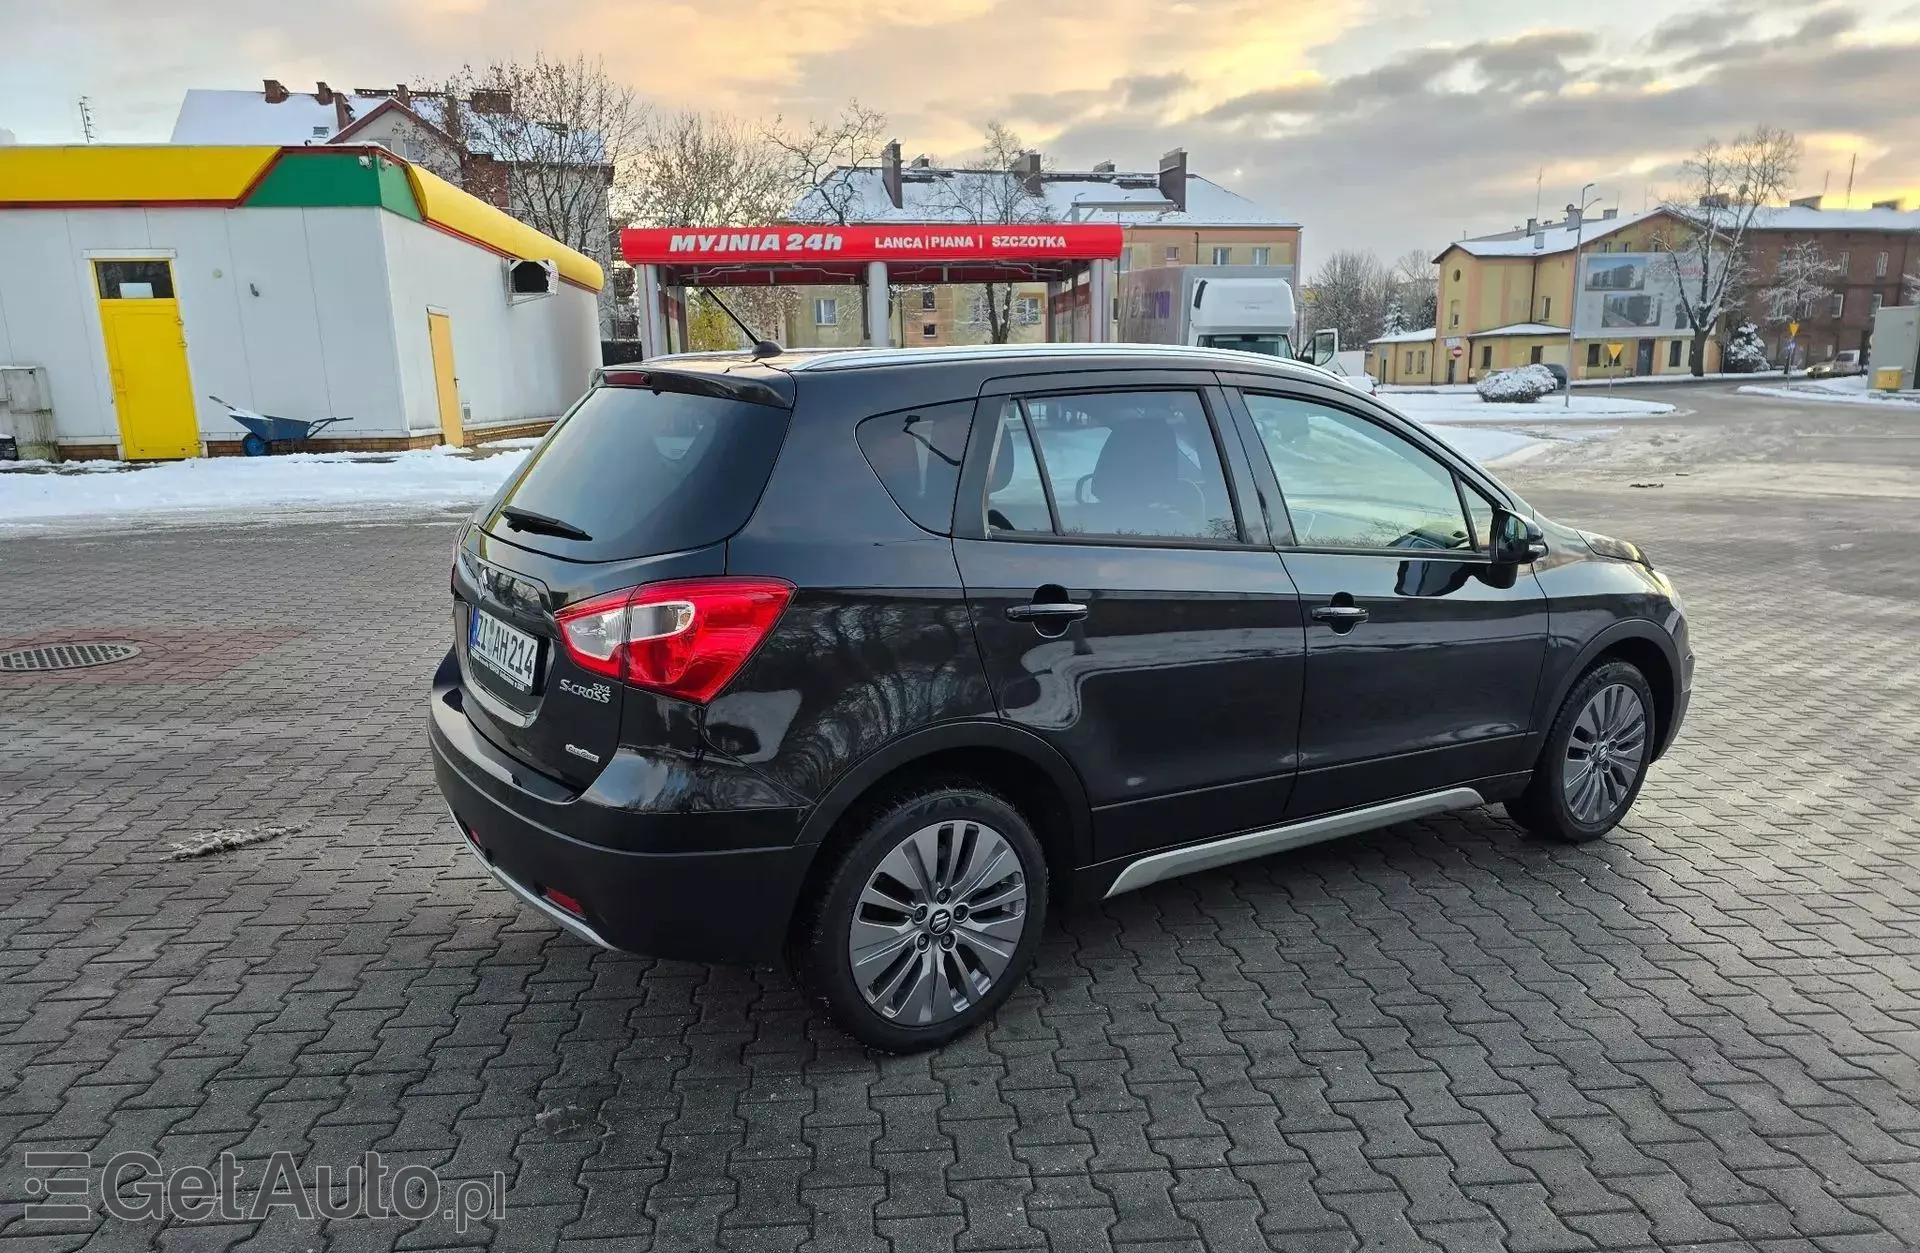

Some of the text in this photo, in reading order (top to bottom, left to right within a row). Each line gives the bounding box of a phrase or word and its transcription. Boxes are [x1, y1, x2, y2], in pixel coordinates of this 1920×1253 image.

[669, 233, 843, 252] MYJNIA 24h
[875, 235, 1067, 249] LANCA PIANA SZCZOTKA
[492, 626, 535, 679] AH214
[593, 682, 611, 694] SX4
